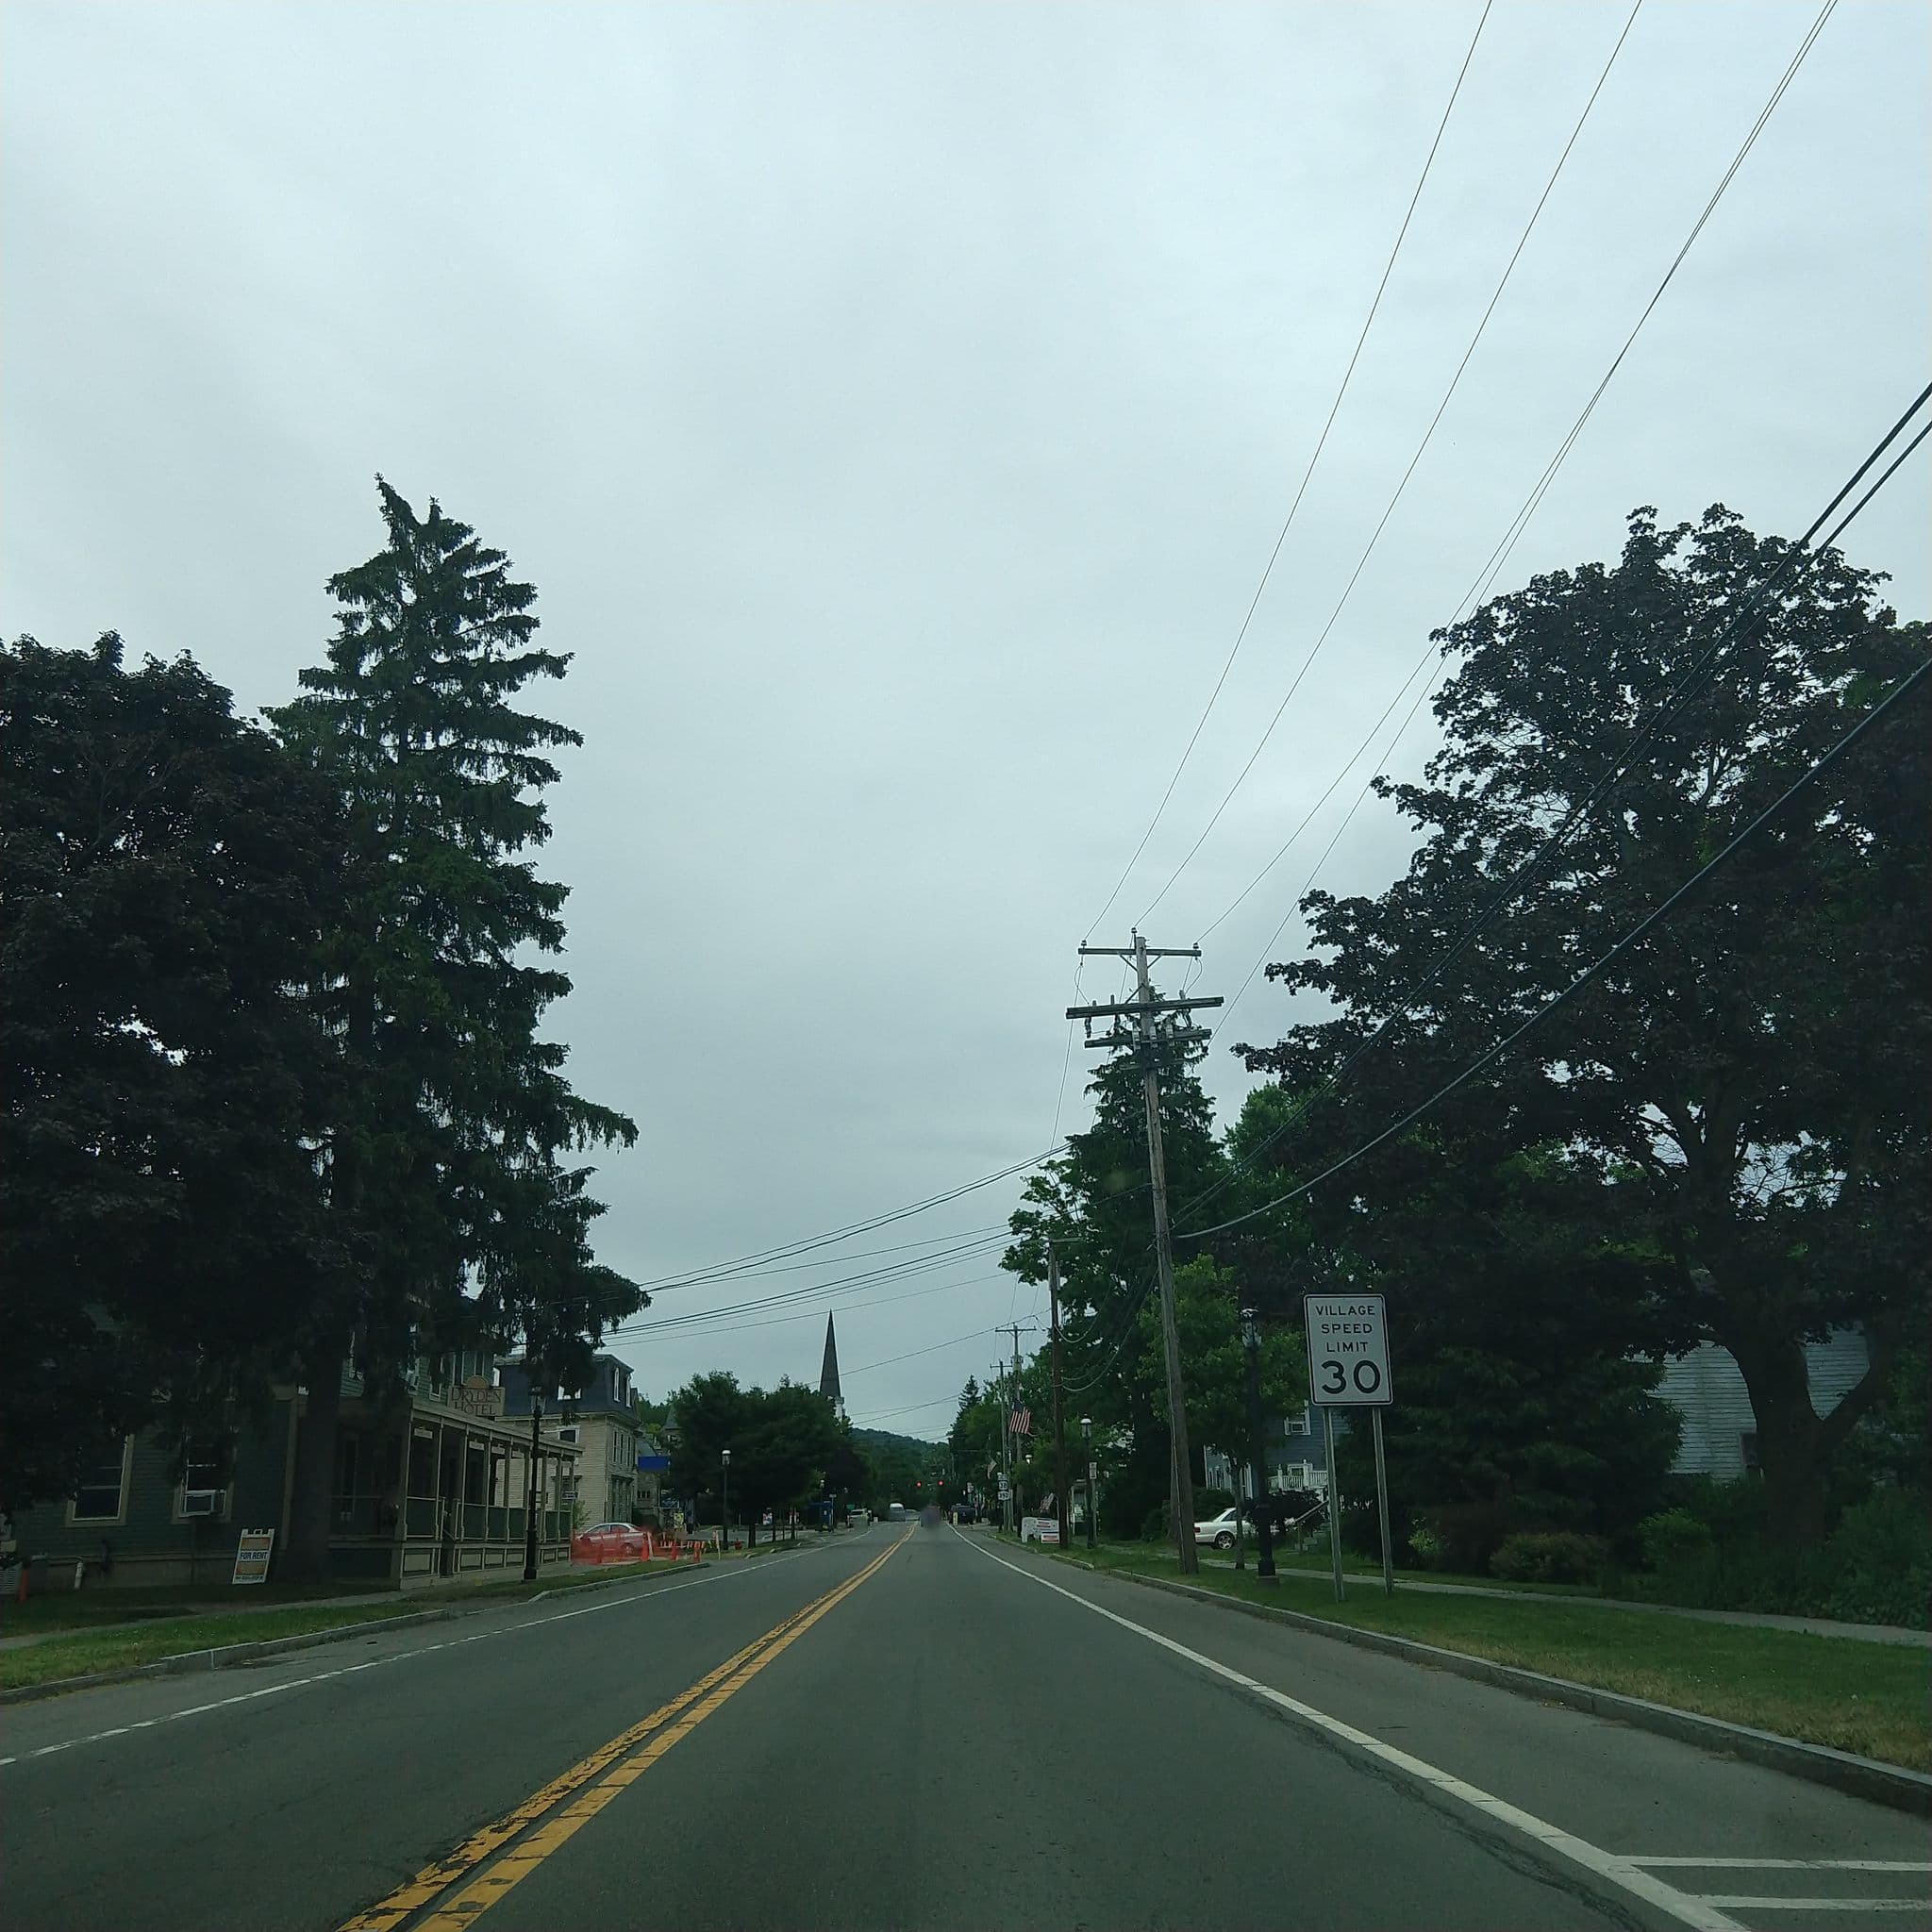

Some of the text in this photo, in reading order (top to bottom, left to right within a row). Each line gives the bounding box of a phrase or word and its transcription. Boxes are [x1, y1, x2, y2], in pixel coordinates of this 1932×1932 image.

[1315, 1306, 1375, 1316] VILLAGE
[1321, 1324, 1373, 1334] SPEED
[1326, 1341, 1369, 1352] LIMIT
[1321, 1360, 1381, 1394] 30
[451, 1388, 501, 1403] DRYDEN
[455, 1402, 495, 1415] HOTEL
[253, 1551, 268, 1559] RENT
